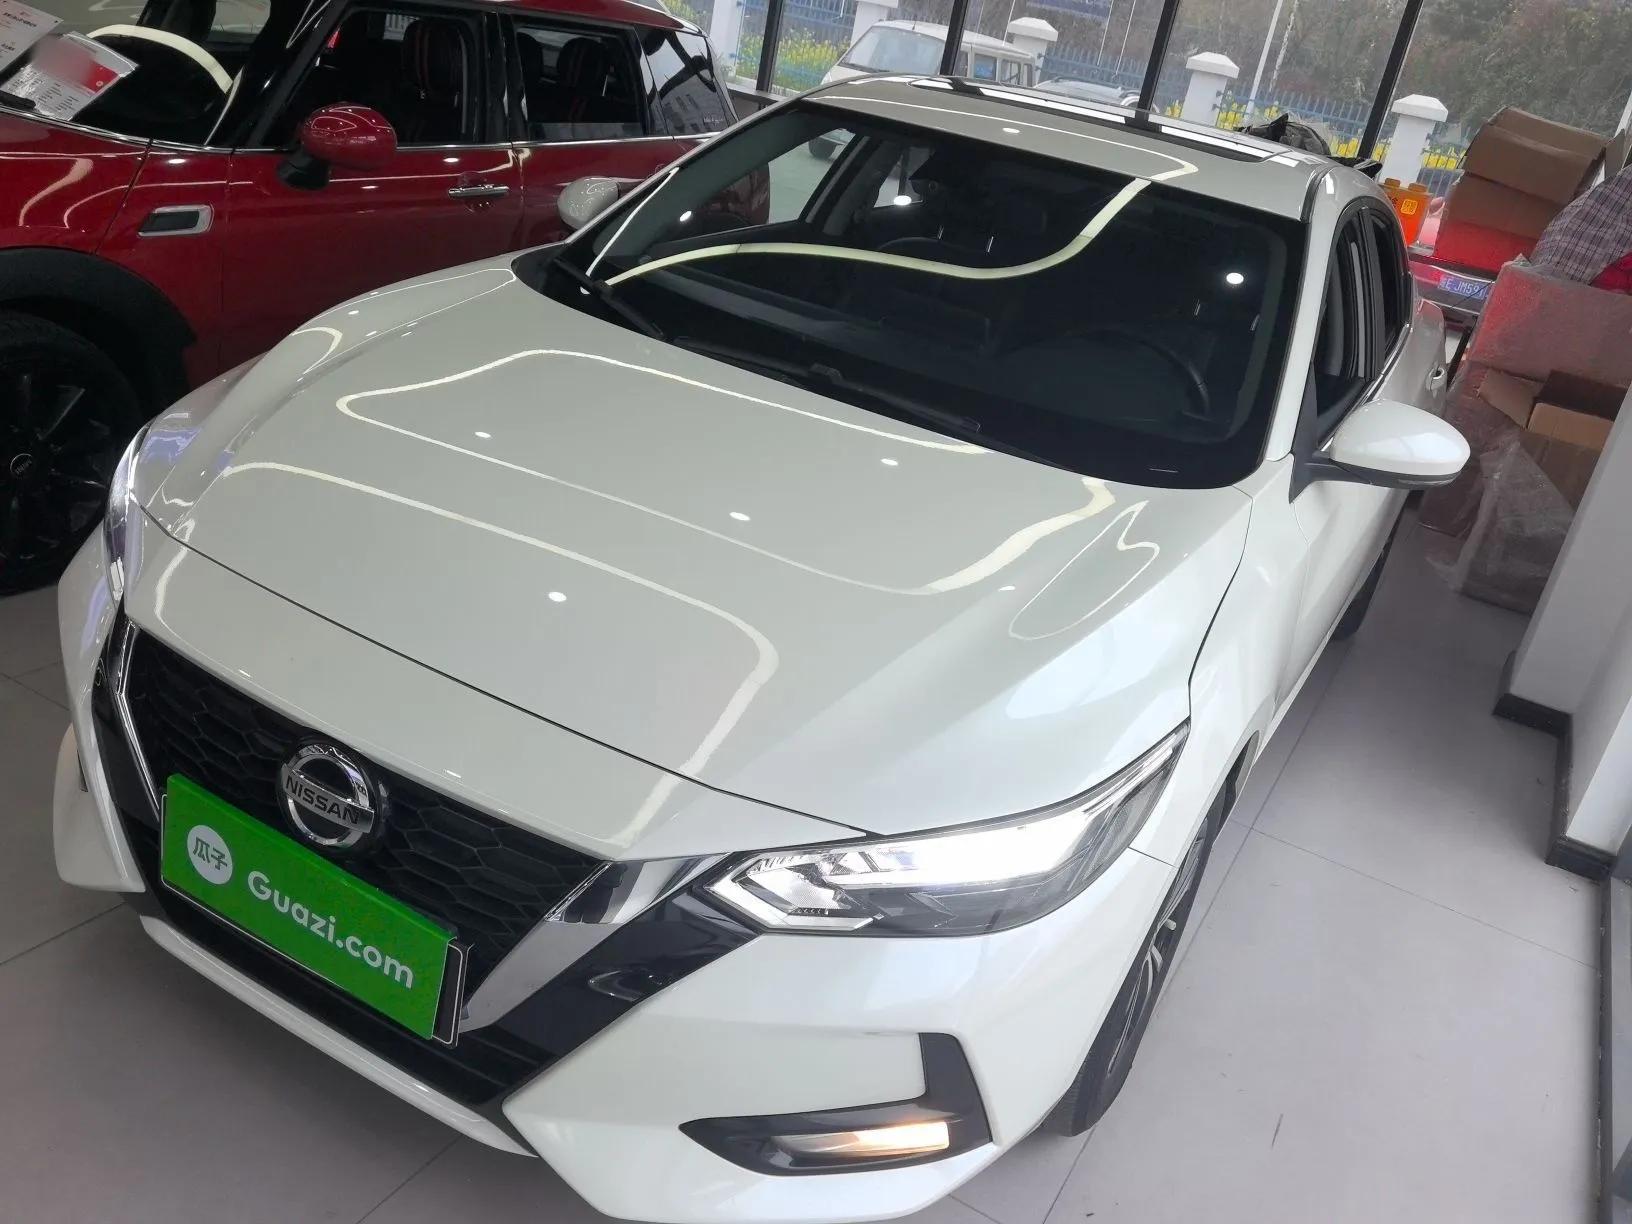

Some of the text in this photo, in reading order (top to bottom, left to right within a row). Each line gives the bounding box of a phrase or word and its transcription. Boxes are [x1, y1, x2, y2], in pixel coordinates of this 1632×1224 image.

[286, 776, 360, 825] NISSAN
[193, 837, 228, 870] 瓜子
[248, 870, 414, 989] Guazi.com
